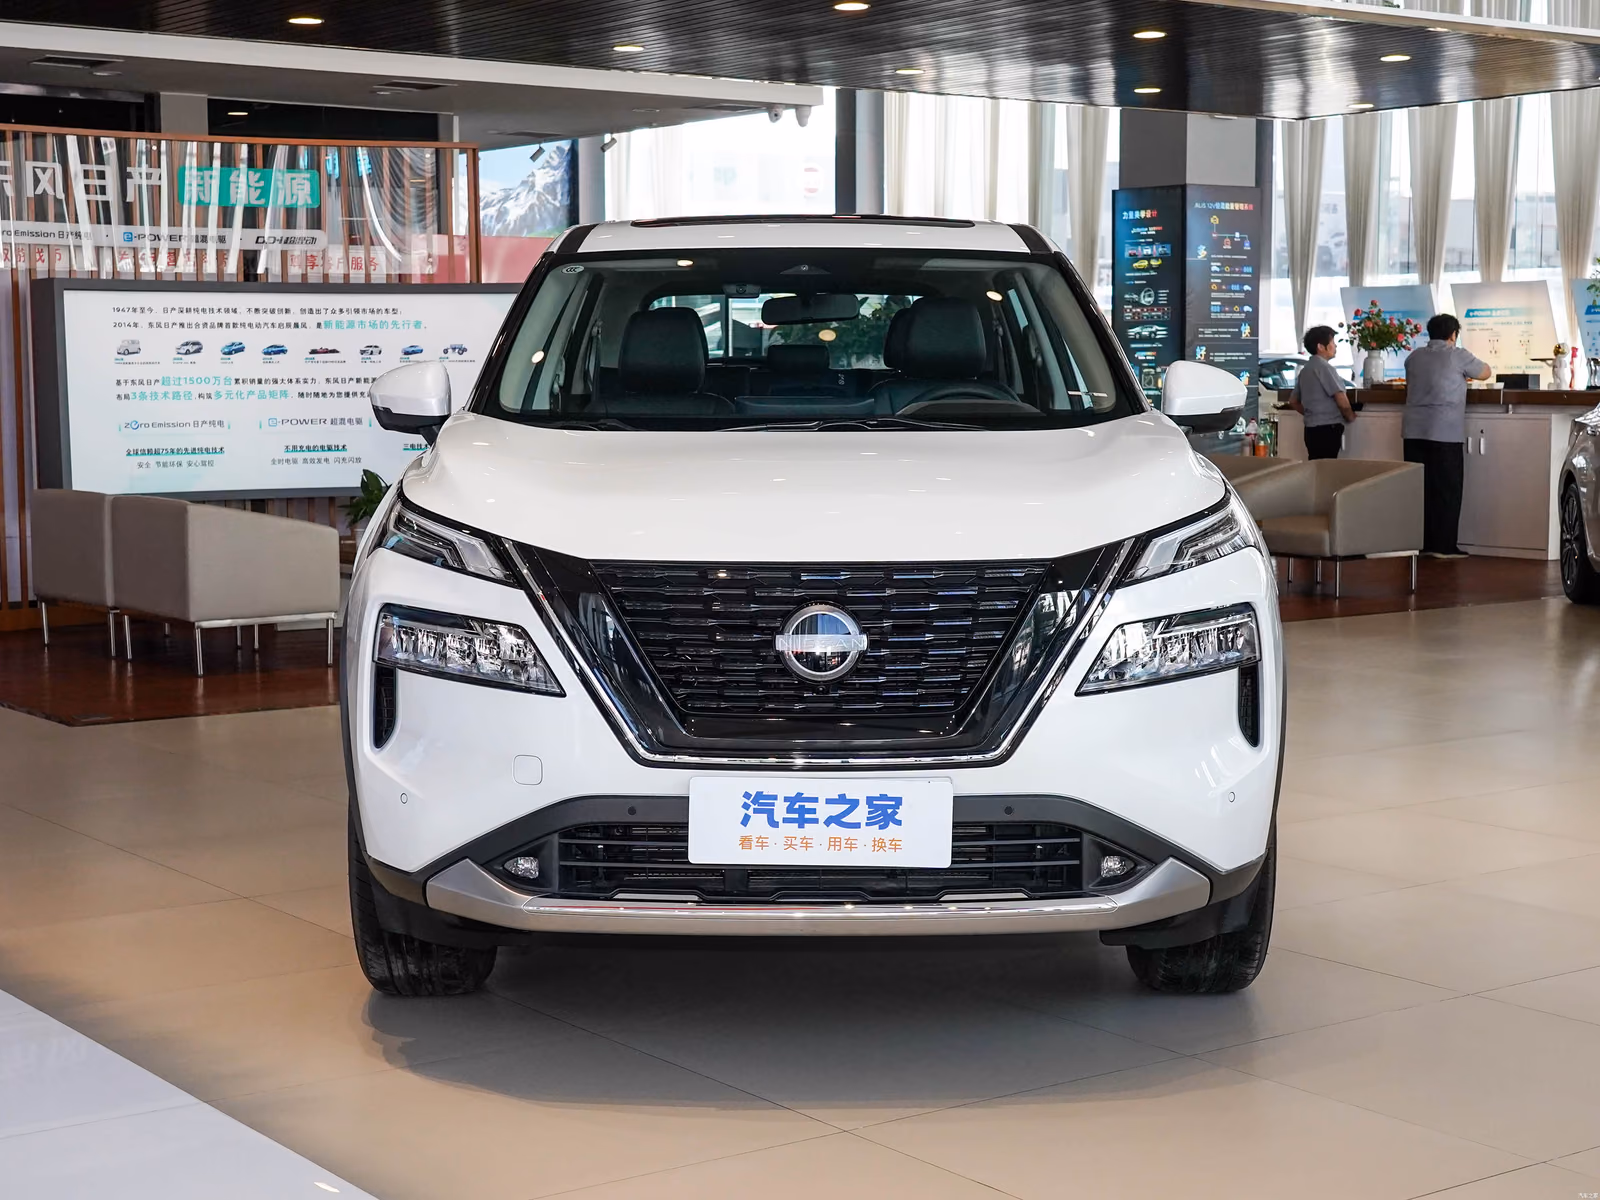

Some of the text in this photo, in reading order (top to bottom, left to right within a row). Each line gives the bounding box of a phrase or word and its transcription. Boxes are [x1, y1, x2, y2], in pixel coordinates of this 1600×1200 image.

[151, 420, 191, 429] Emission
[192, 419, 225, 429] 日产纯电
[329, 417, 363, 426] 超混电驱
[739, 790, 903, 830] 汽车之家
